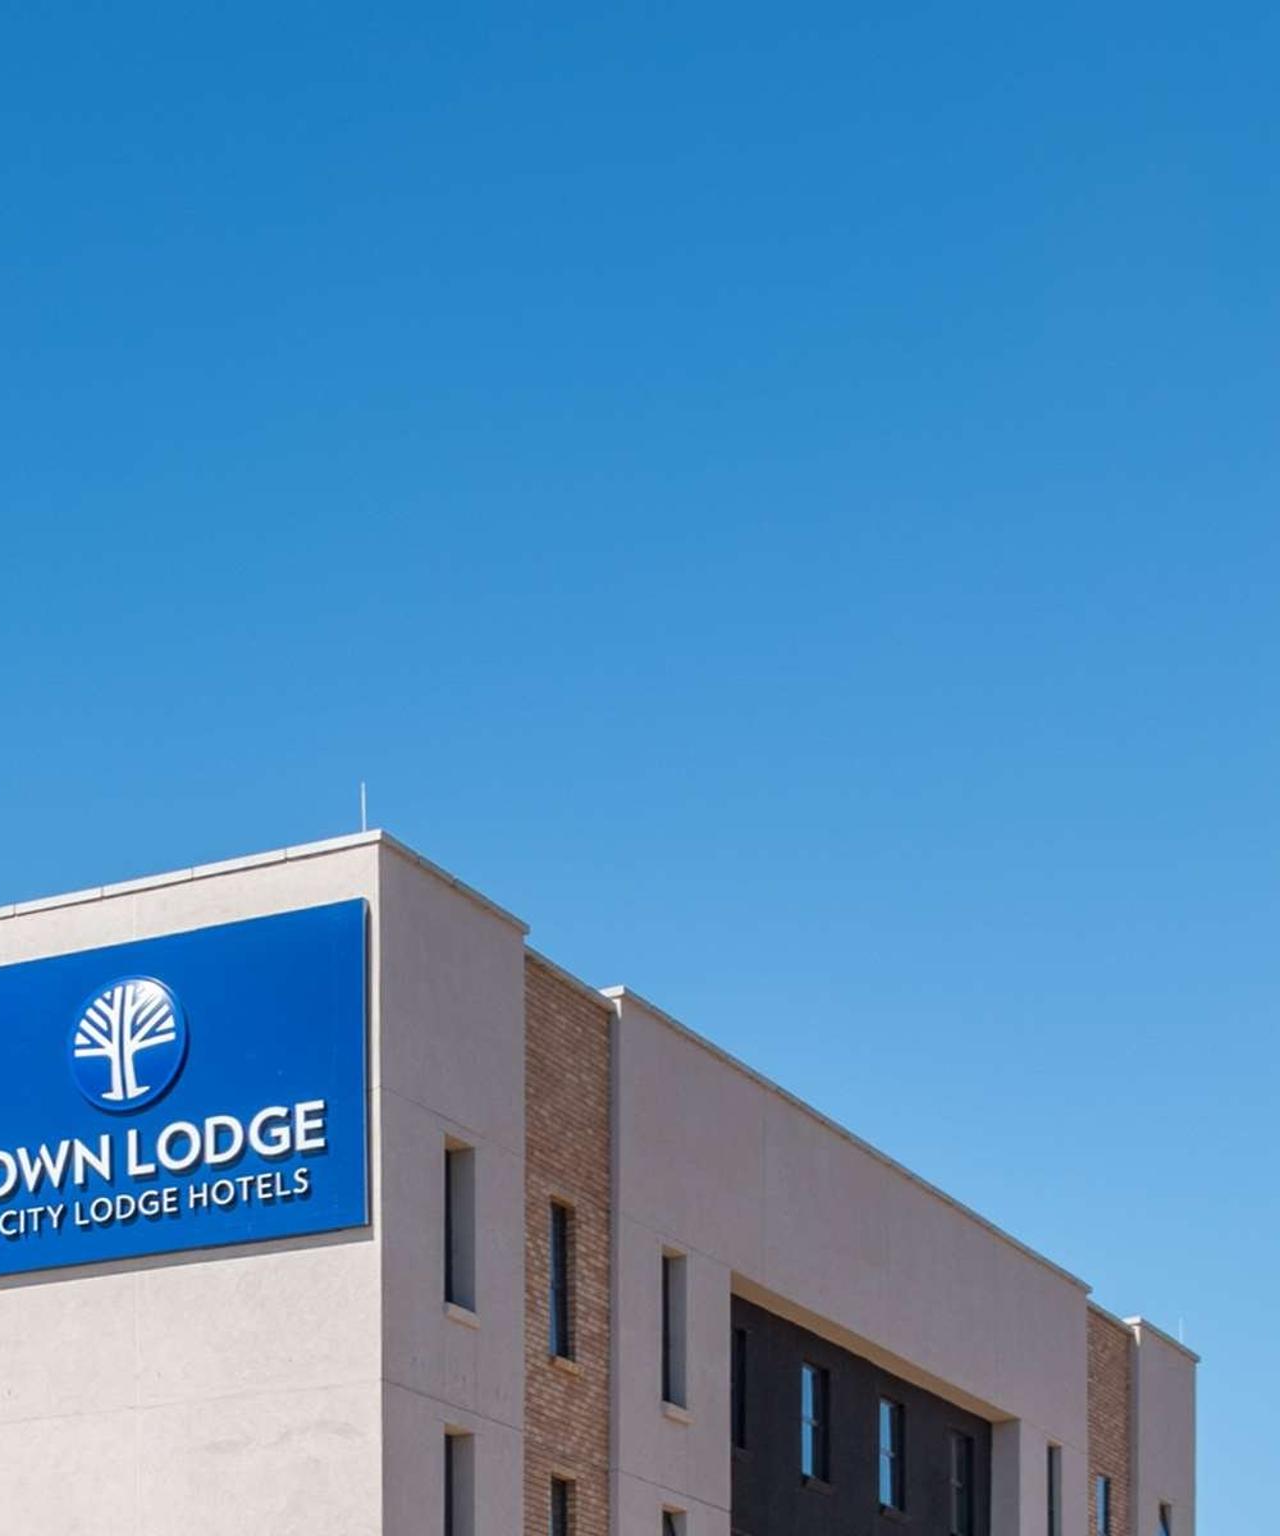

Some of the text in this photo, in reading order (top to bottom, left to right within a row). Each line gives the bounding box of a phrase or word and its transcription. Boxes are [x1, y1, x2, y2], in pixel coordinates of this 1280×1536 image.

[126, 1099, 326, 1177] LODGE
[75, 1187, 178, 1225] LODGE
[189, 1167, 308, 1209] HOTELS
